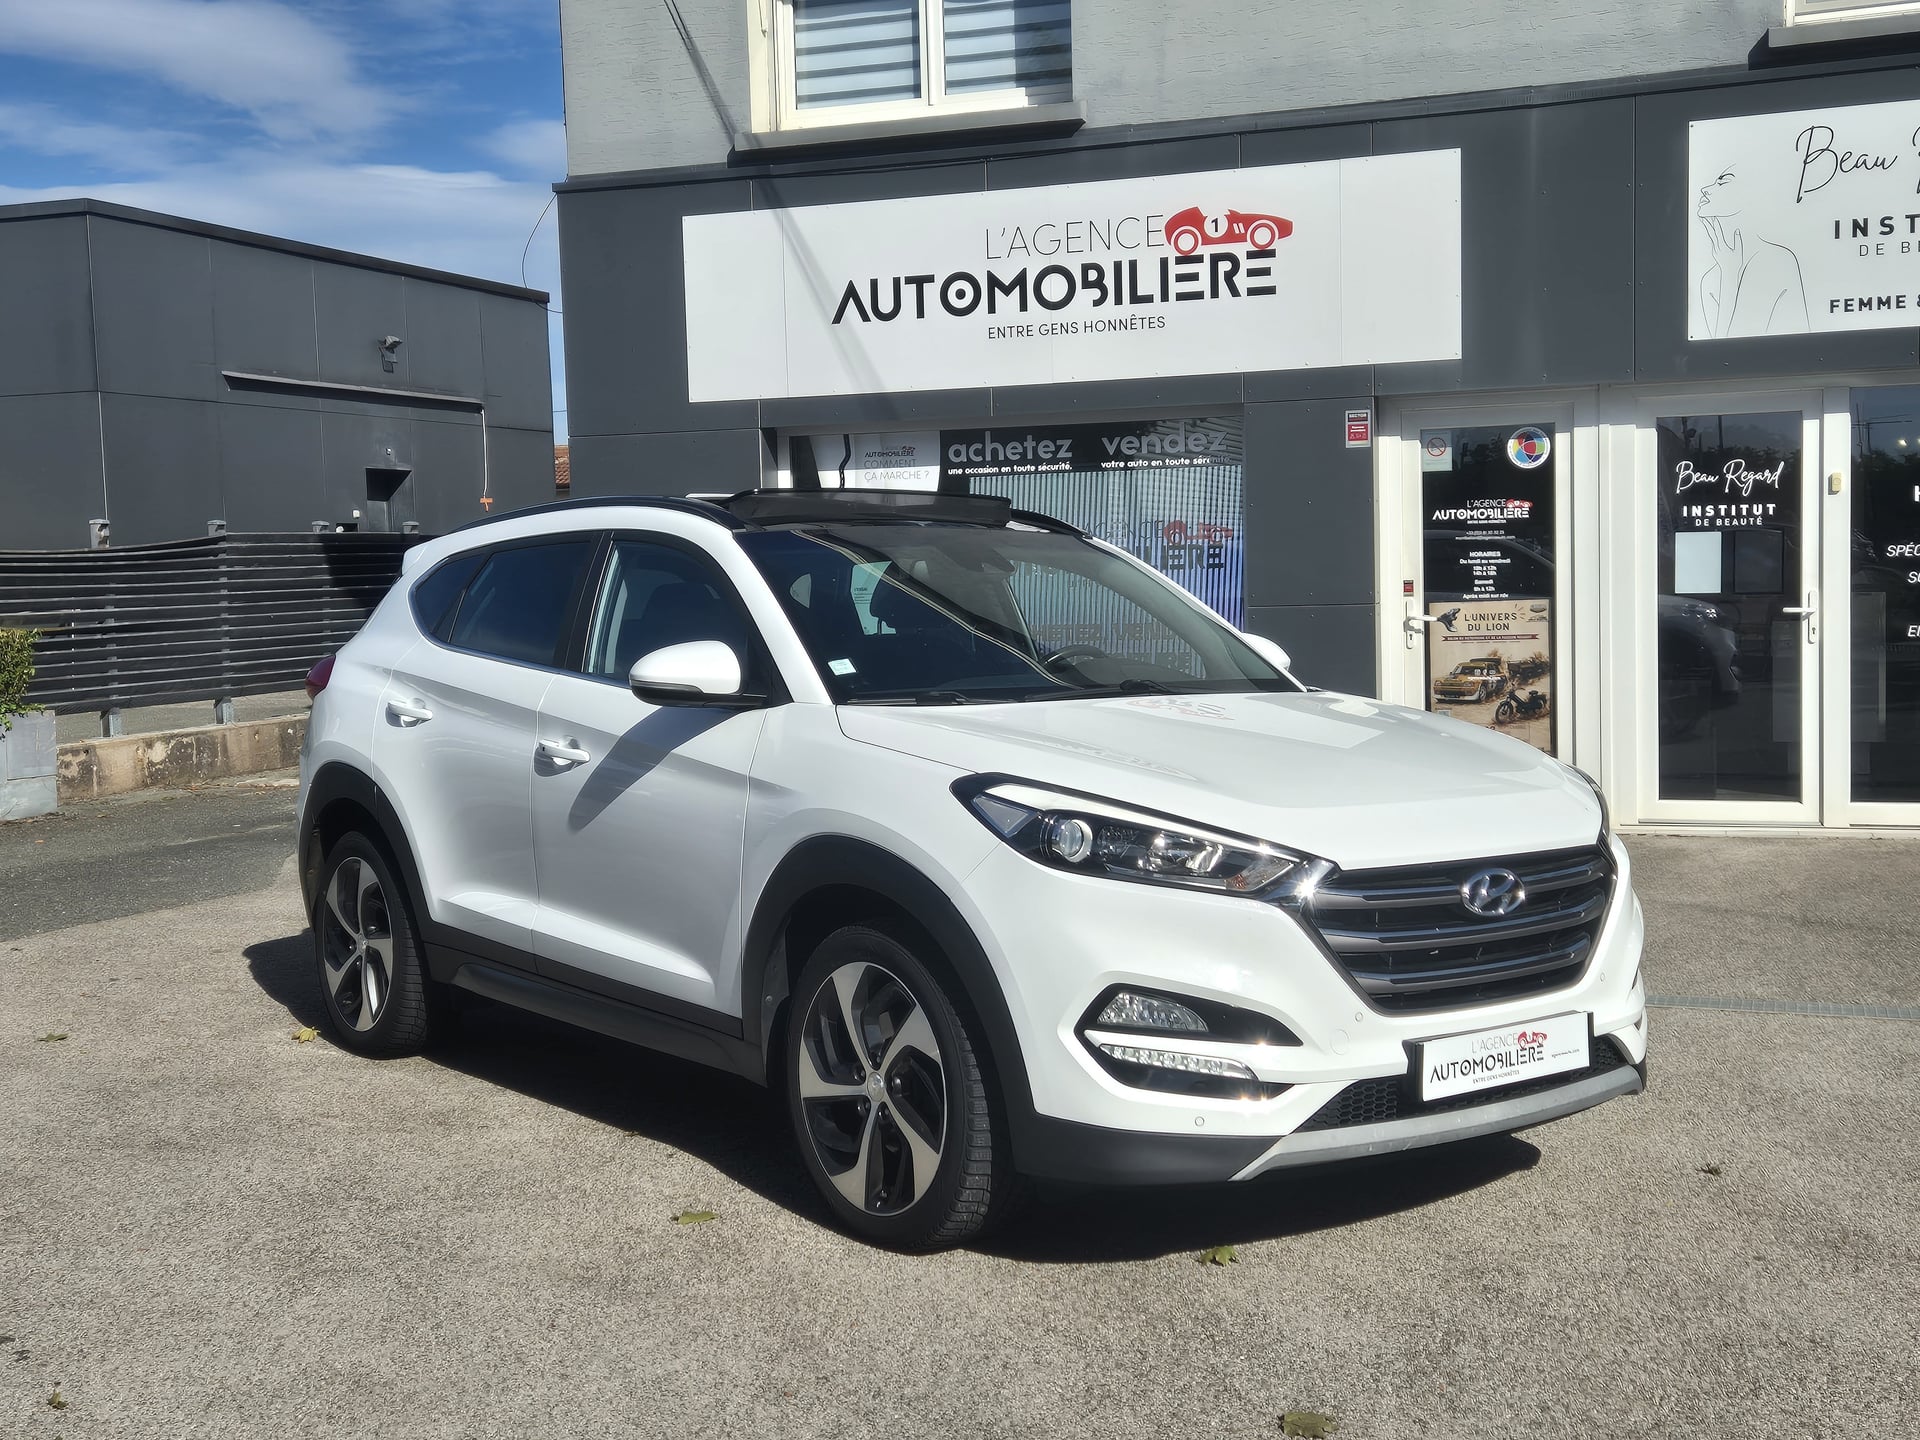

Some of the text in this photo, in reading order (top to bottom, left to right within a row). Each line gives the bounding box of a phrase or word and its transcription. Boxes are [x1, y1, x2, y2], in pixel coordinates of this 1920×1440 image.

[1795, 125, 1898, 204] Beau
[986, 214, 1165, 260] L'AGENCE
[1859, 240, 1920, 257] DE B
[1829, 294, 1907, 314] FEMME
[988, 314, 1166, 339] ENTRE GENS HONNÊTES
[948, 430, 1073, 463] achetez
[1101, 421, 1228, 456] vendez
[863, 458, 917, 469] COMMENT
[965, 465, 999, 474] occasion
[1014, 464, 1036, 472] toute
[1038, 461, 1073, 471] sécurité.
[1101, 460, 1125, 469] votre
[1127, 459, 1149, 468] auto
[1151, 459, 1163, 467] en
[1165, 457, 1191, 466] toute
[863, 471, 878, 483] ÇA
[880, 469, 921, 480] MARCHE
[1676, 458, 1785, 497] Beau Regard
[1466, 498, 1507, 508] L'AGENCE
[1683, 503, 1777, 517] INSTITUT
[1695, 516, 1763, 527] DE BEAUTÉ
[1467, 622, 1510, 631] DU LION
[1471, 1032, 1518, 1054] L'AGENCE
